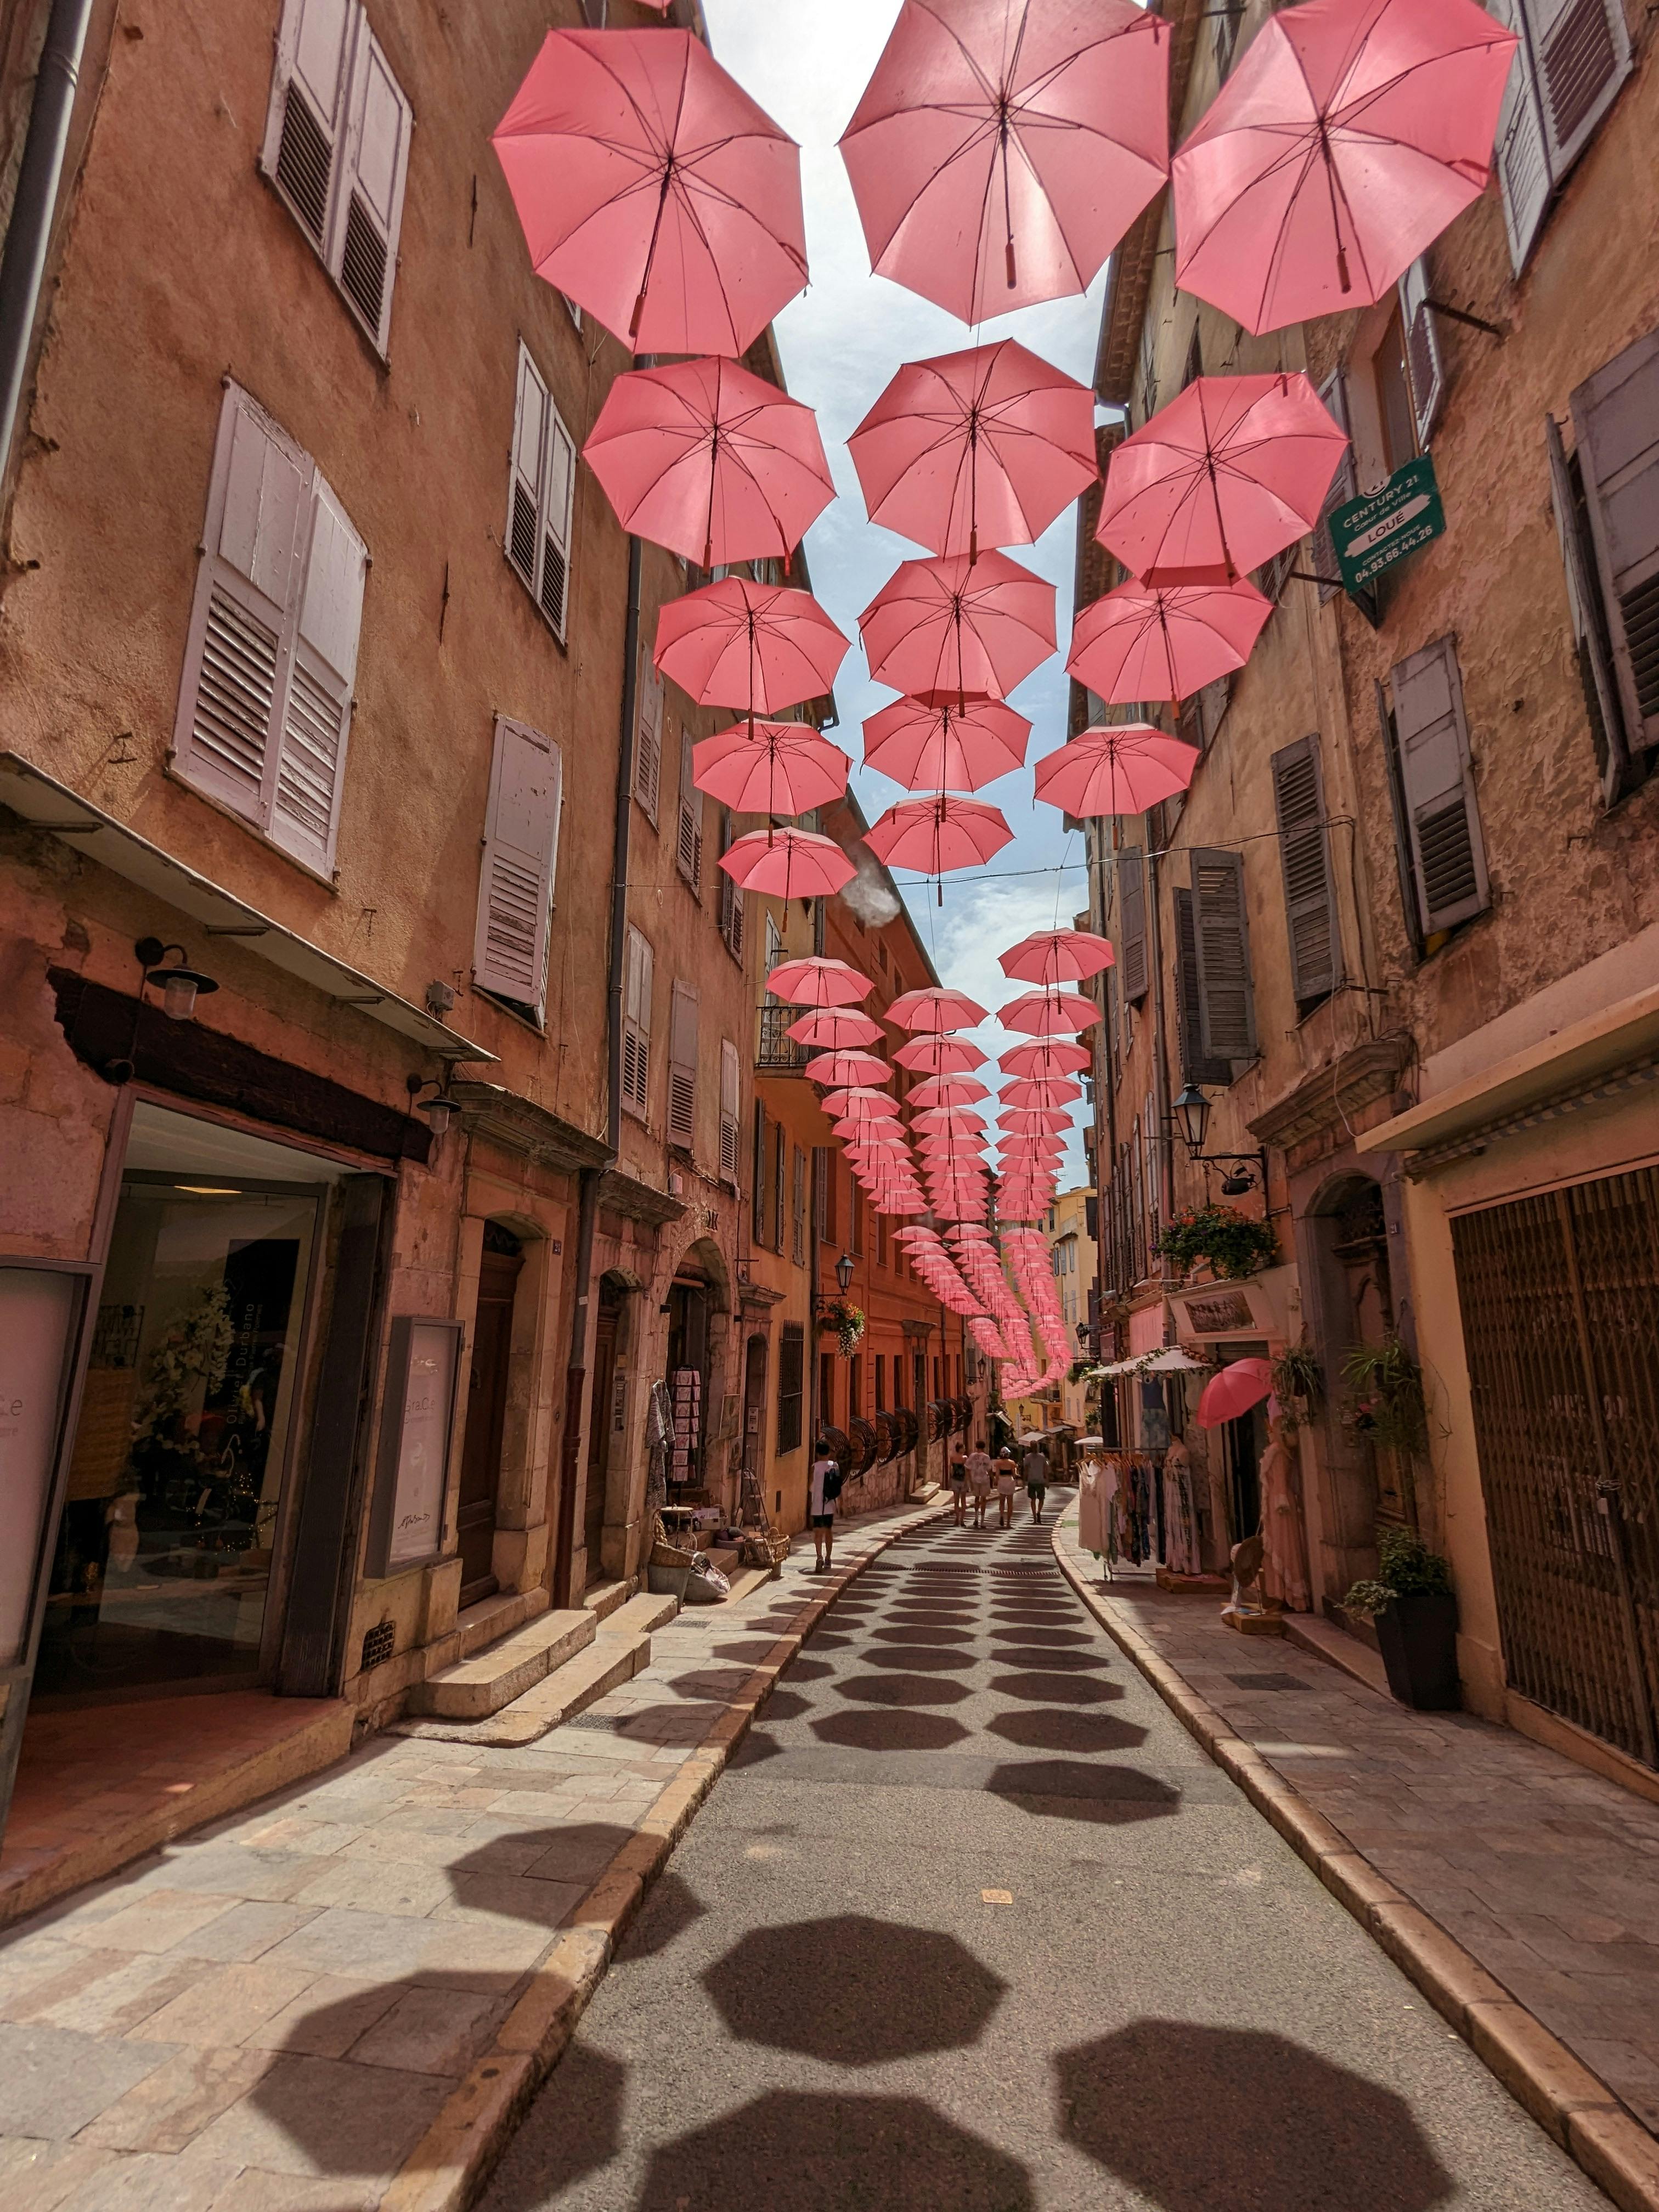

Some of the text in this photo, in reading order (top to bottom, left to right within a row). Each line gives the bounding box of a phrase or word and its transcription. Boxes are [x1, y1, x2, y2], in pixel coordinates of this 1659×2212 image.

[1344, 475, 1420, 528] CENTURY 21
[1380, 506, 1390, 516] de
[1392, 492, 1412, 506] Ville
[1362, 524, 1421, 566] CONTACTEZ-NOUS
[1368, 511, 1405, 543] LOUÉ
[1355, 526, 1433, 583] 04.93.66.44.26
[236, 1304, 254, 1365] Durbano
